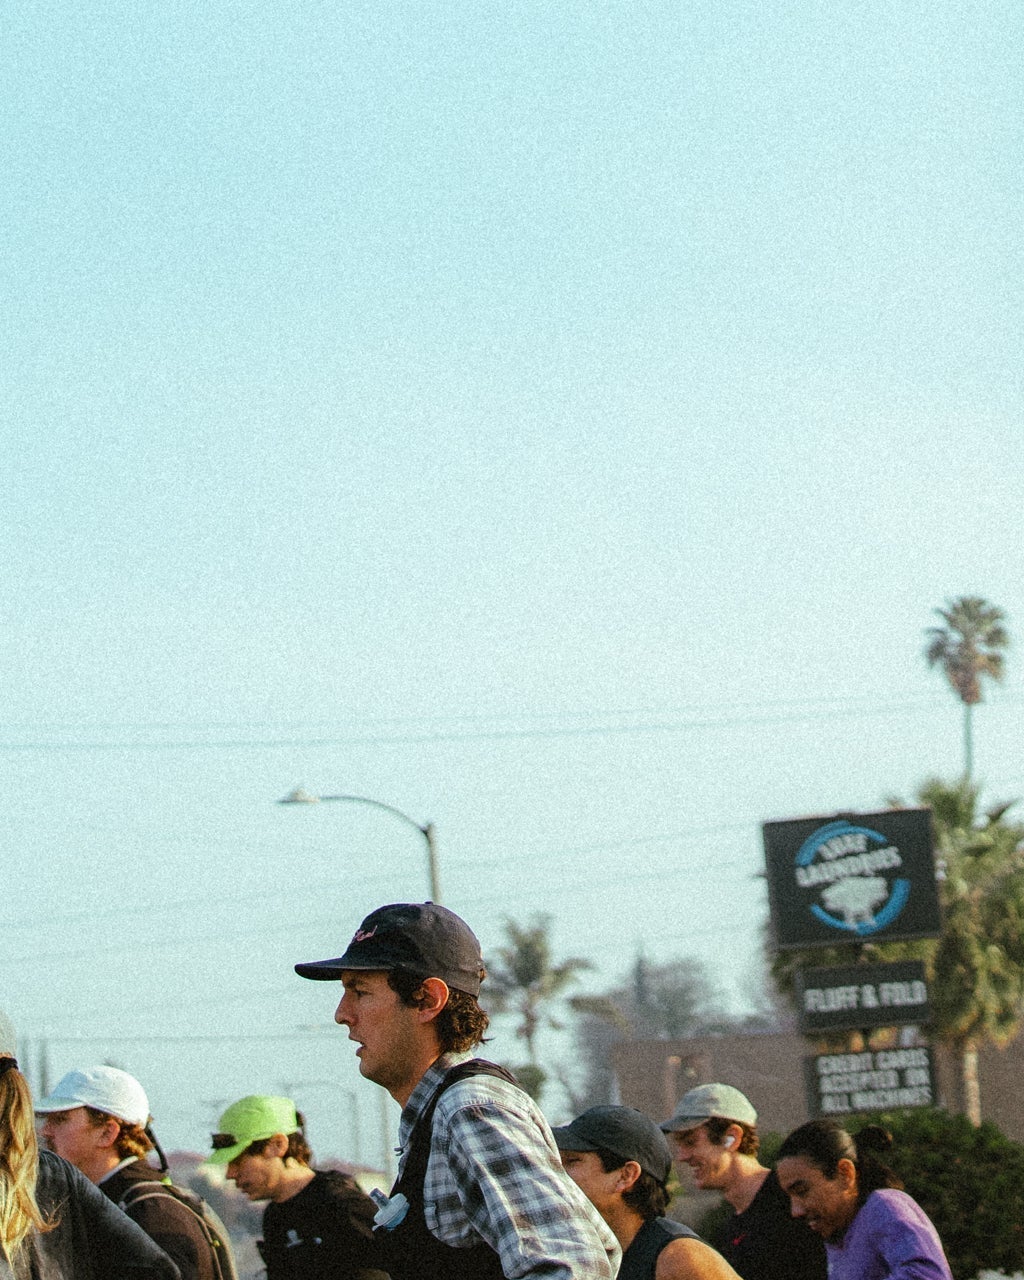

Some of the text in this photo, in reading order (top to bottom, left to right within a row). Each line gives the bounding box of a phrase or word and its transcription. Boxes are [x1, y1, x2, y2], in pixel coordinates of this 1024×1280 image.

[803, 980, 927, 1013] FLUFF & FOLD
[817, 1048, 930, 1075] CREDIT CARDS
[819, 1069, 899, 1093] ACCEPTED
[821, 1085, 933, 1113] ALL MACHINES
